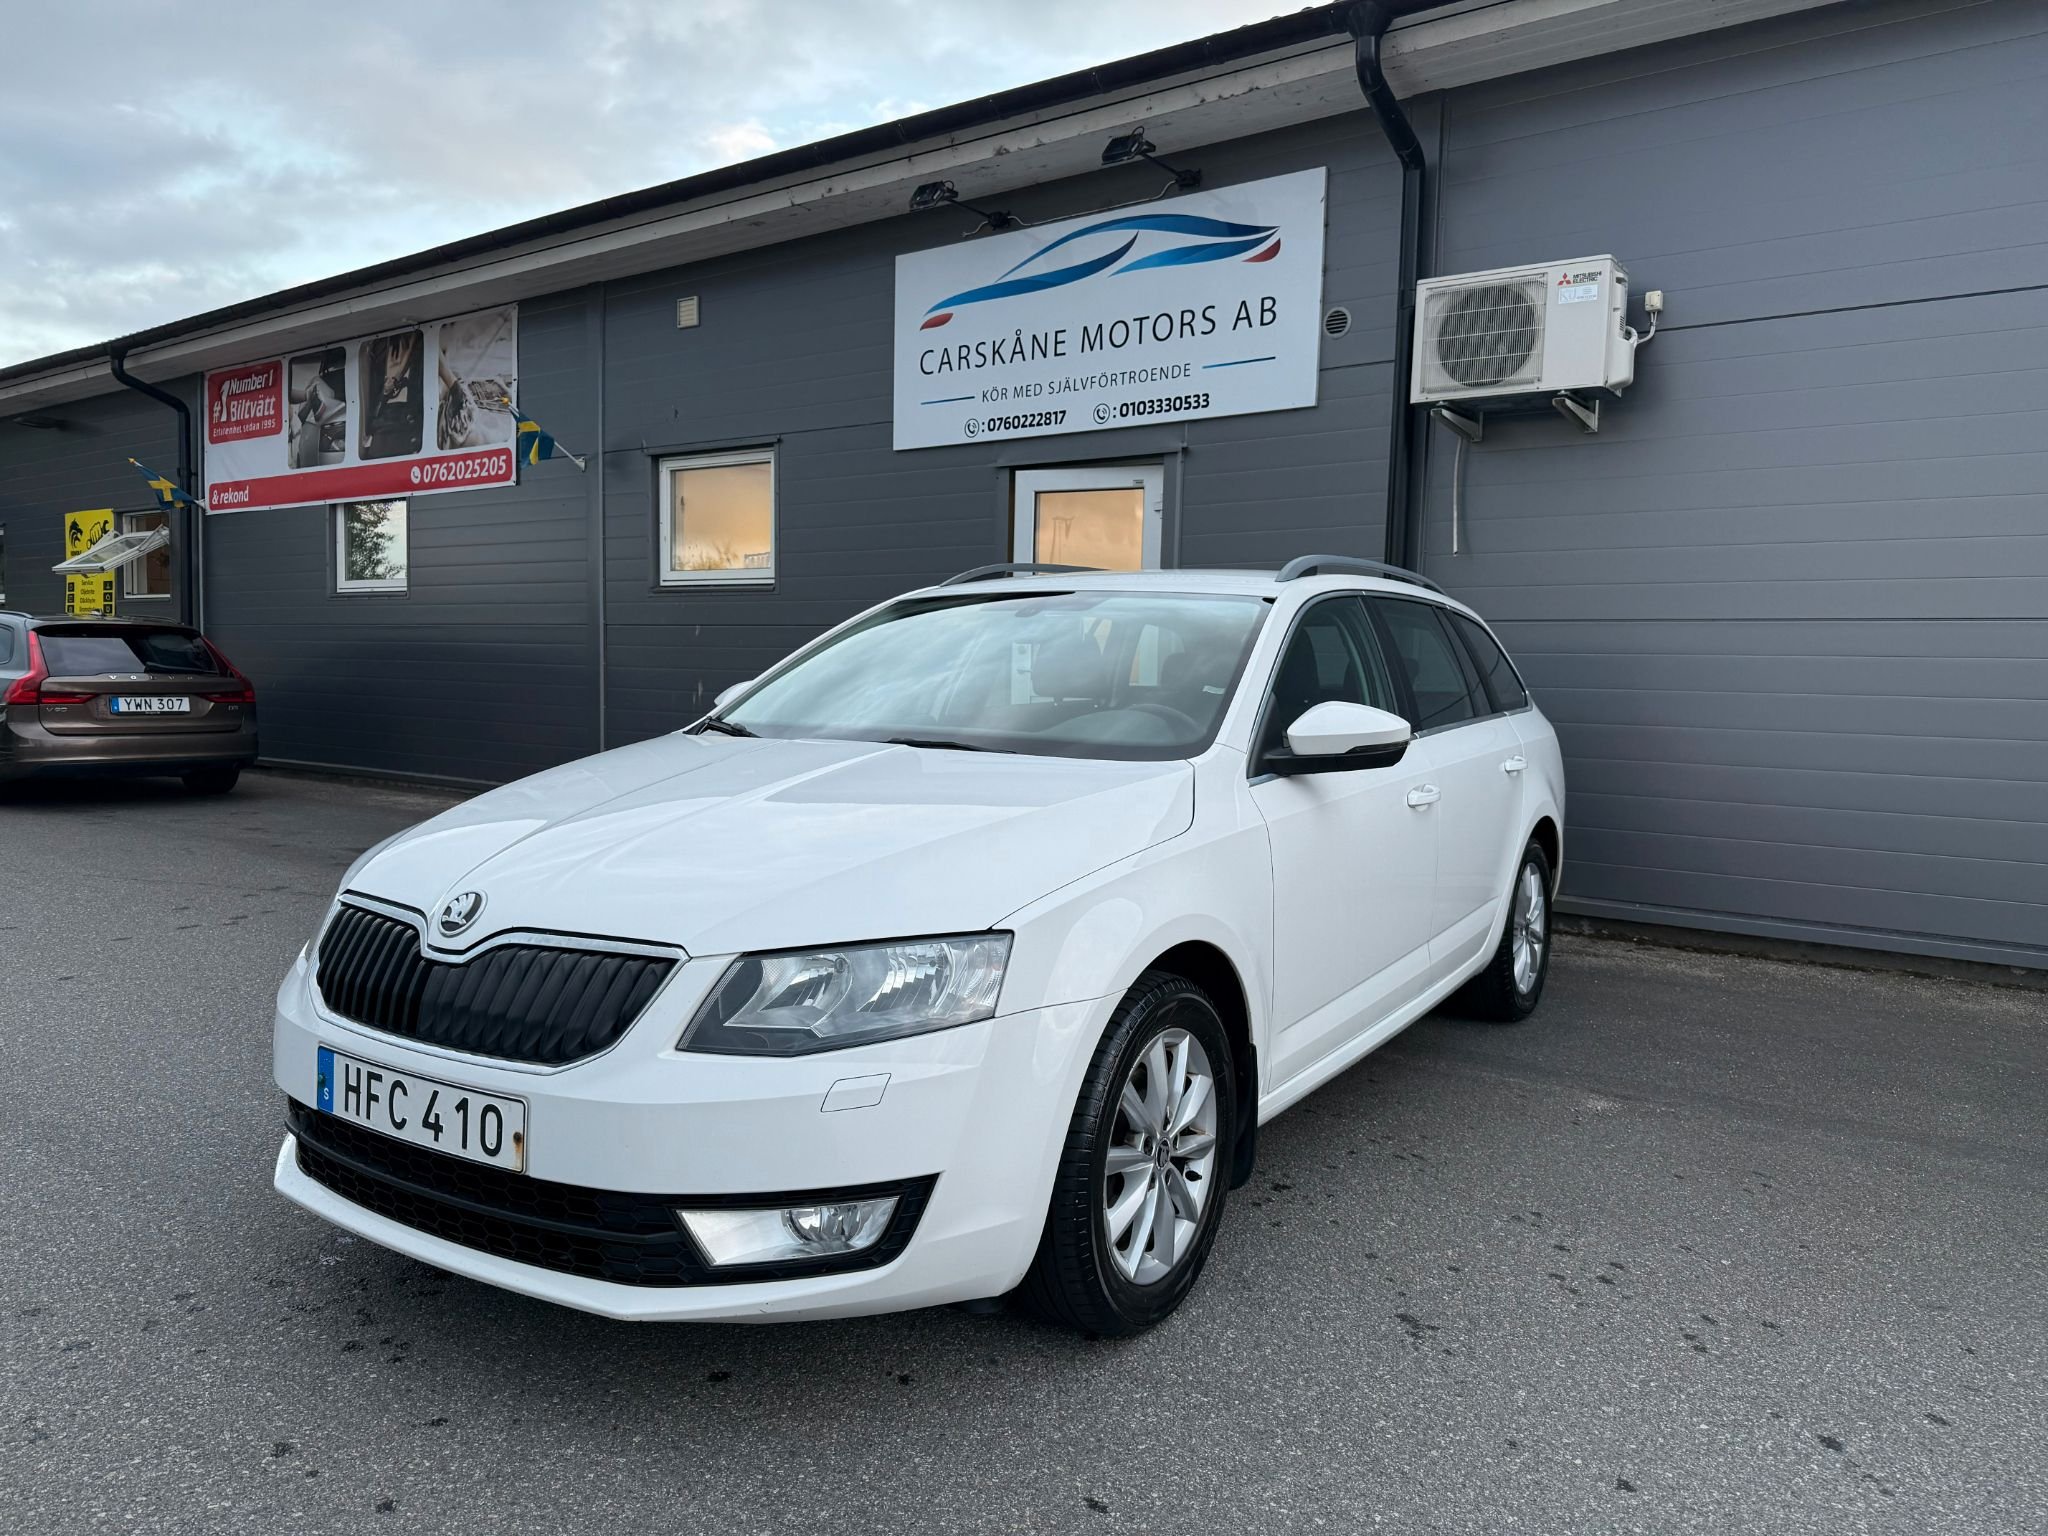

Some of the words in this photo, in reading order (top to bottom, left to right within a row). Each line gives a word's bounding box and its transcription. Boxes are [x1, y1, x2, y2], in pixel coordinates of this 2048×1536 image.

[920, 329, 1067, 376] CARSKÅNE
[1080, 305, 1217, 353] MOTORS
[1232, 296, 1278, 331] AB
[229, 373, 268, 396] Number
[981, 388, 1009, 404] KÖR
[1013, 383, 1043, 399] MED
[1048, 362, 1192, 395] SJÄLVFÖRTROENDE
[230, 394, 276, 422] Biltvätt
[243, 421, 260, 433] sedan
[261, 418, 276, 430] 1995
[423, 455, 507, 482] 0762025205
[212, 490, 219, 505] &
[220, 485, 249, 503] rekond
[124, 699, 154, 711] YWN
[157, 698, 184, 711] 307
[323, 1087, 331, 1101] S
[344, 1063, 409, 1131] HFC
[421, 1089, 504, 1157] 410
